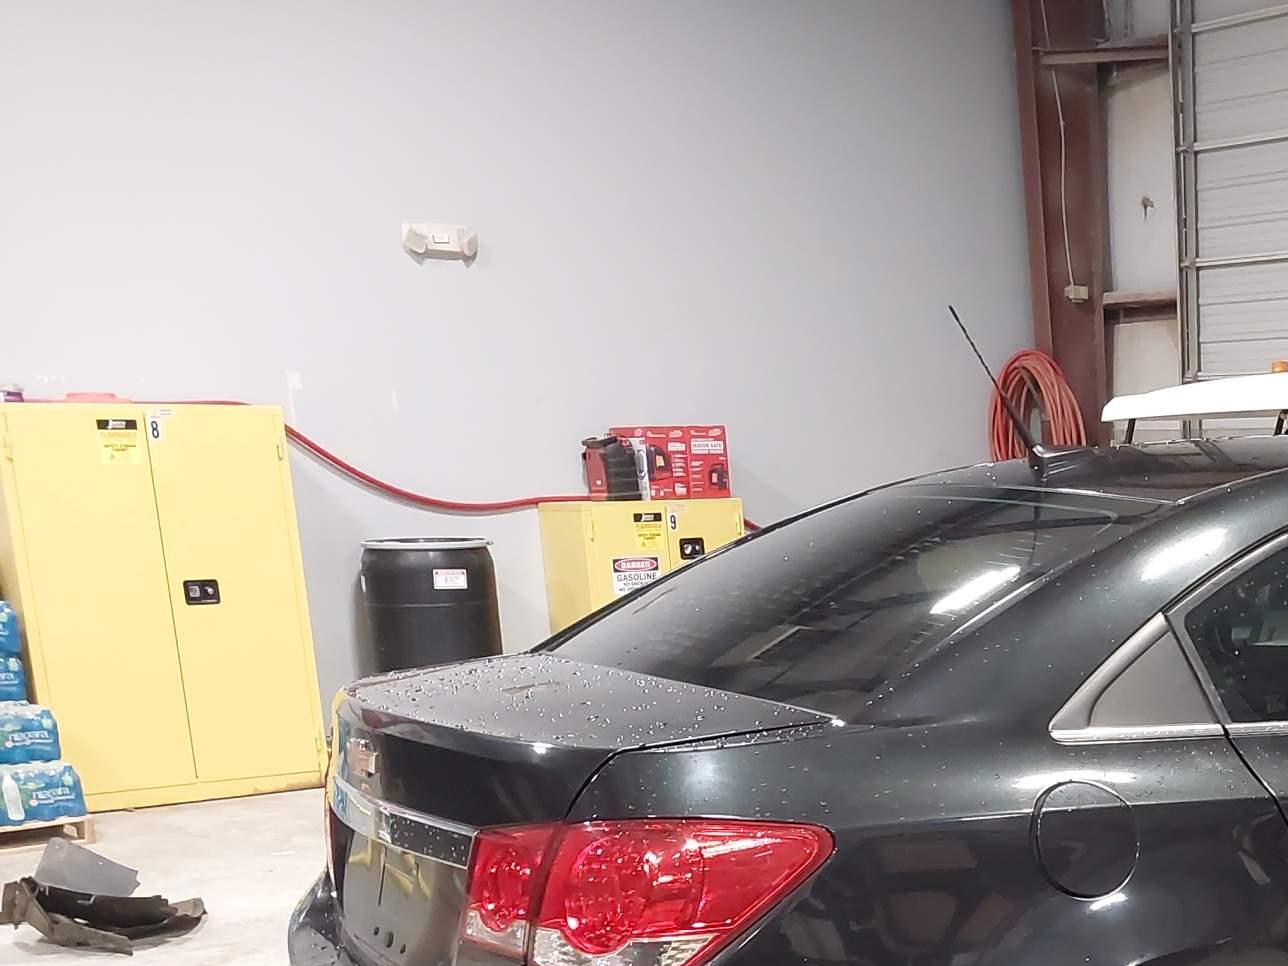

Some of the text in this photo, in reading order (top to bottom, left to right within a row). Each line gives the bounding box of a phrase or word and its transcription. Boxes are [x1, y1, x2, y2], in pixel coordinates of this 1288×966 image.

[150, 420, 160, 439] 8
[669, 513, 677, 530] 9
[616, 572, 657, 582] GASOLINE
